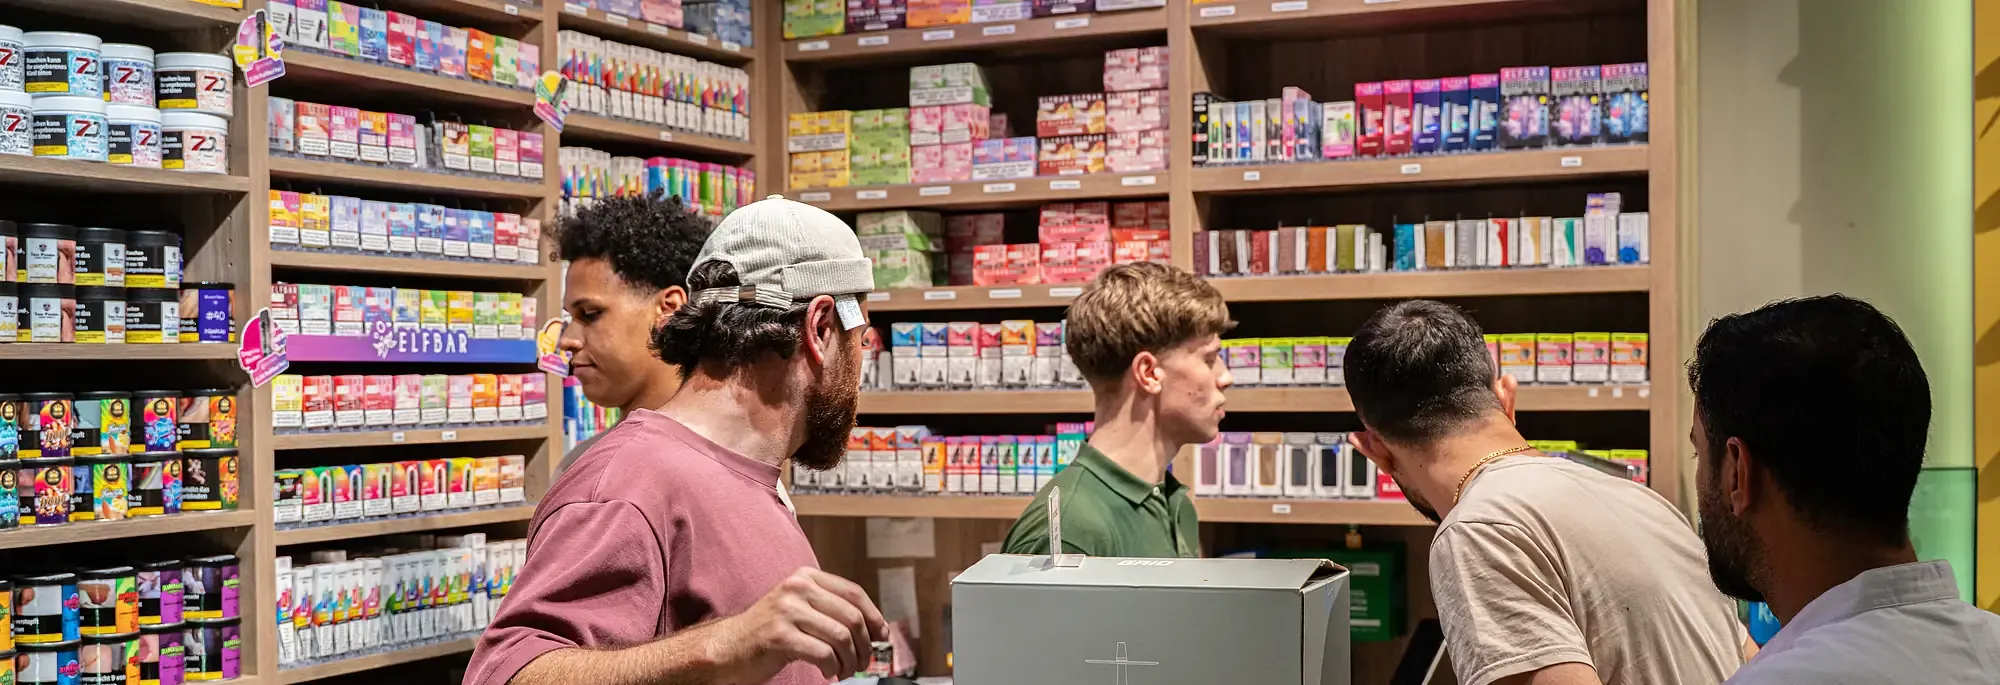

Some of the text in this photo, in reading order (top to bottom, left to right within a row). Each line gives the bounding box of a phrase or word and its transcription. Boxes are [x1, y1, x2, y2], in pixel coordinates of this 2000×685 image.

[1504, 69, 1546, 79] ELFBAR
[1555, 69, 1596, 80] ELFBAR
[205, 311, 226, 321] #40
[399, 331, 468, 353] ELFBAR
